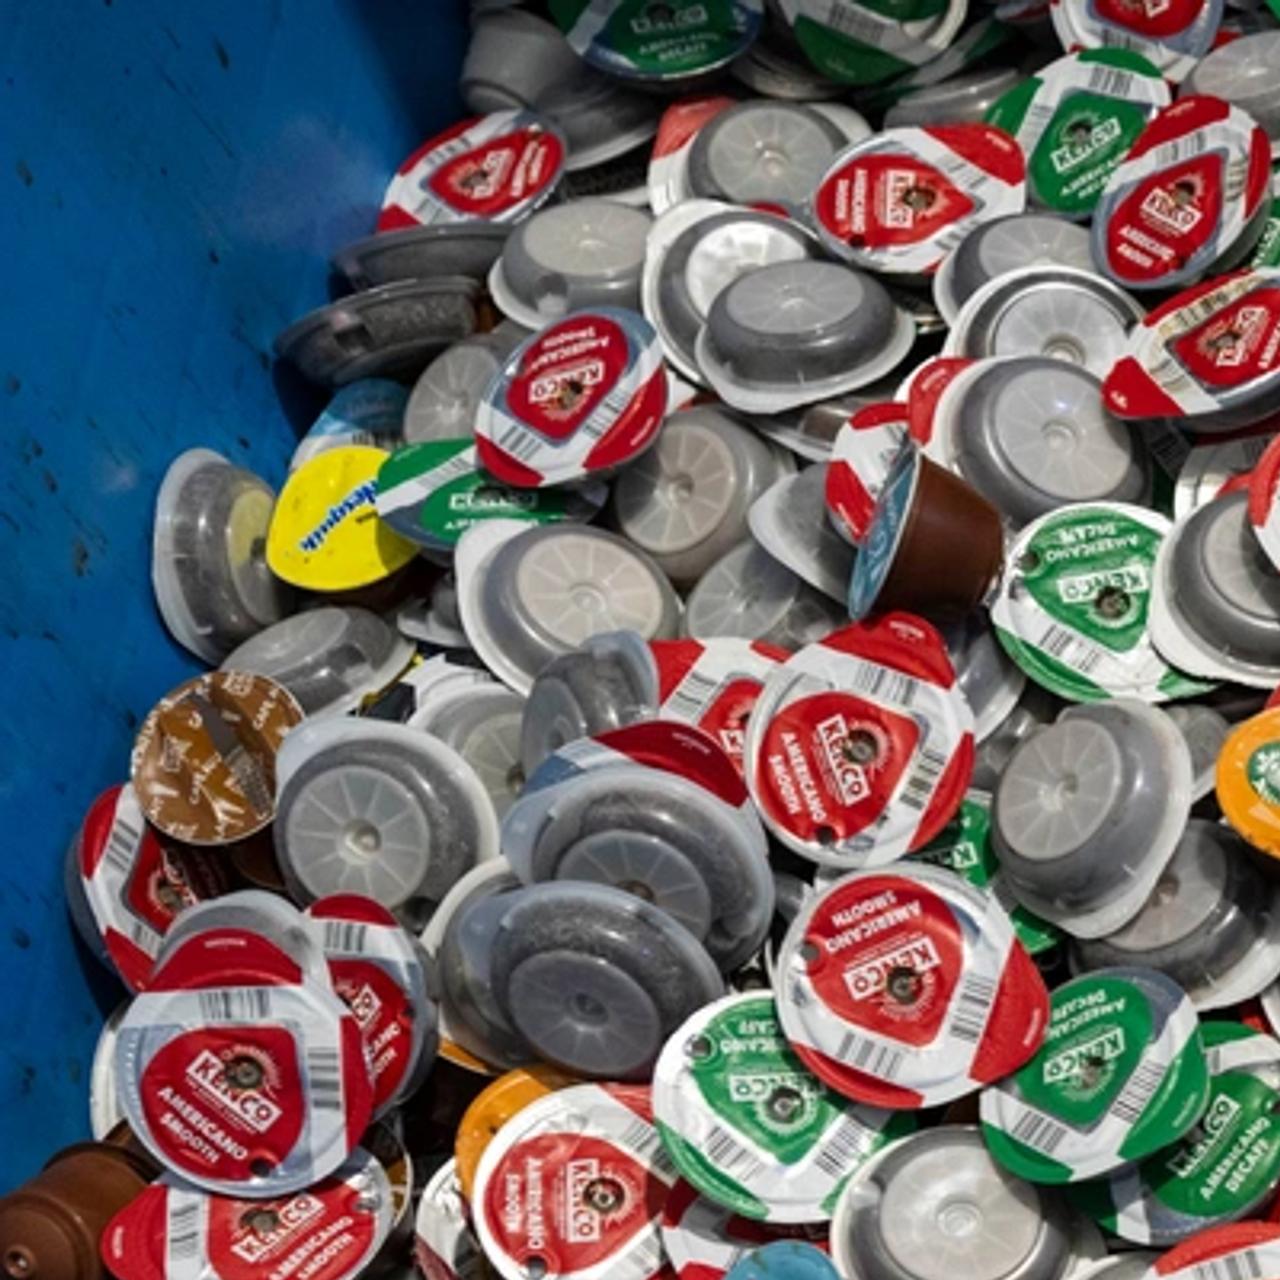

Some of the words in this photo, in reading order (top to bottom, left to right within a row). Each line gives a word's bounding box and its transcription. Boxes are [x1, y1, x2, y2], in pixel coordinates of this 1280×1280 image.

[1046, 535, 1138, 563] AMERICANO
[1060, 525, 1116, 543] DECAFF
[770, 755, 798, 815] SMOOTH
[781, 732, 826, 823] AMERICANO
[825, 902, 920, 952] AMERICANO
[833, 892, 896, 924] SMOOTH
[192, 1055, 271, 1126] KENCO
[158, 1088, 247, 1159] AMERICANO
[161, 1113, 218, 1162] SMOOTH
[1202, 1117, 1270, 1199] AMERICANO
[1229, 1140, 1266, 1189] DECAFF
[506, 1173, 521, 1234] SMOOTH
[527, 1158, 542, 1249] AMERICANO
[300, 1233, 352, 1278] SMOOTH
